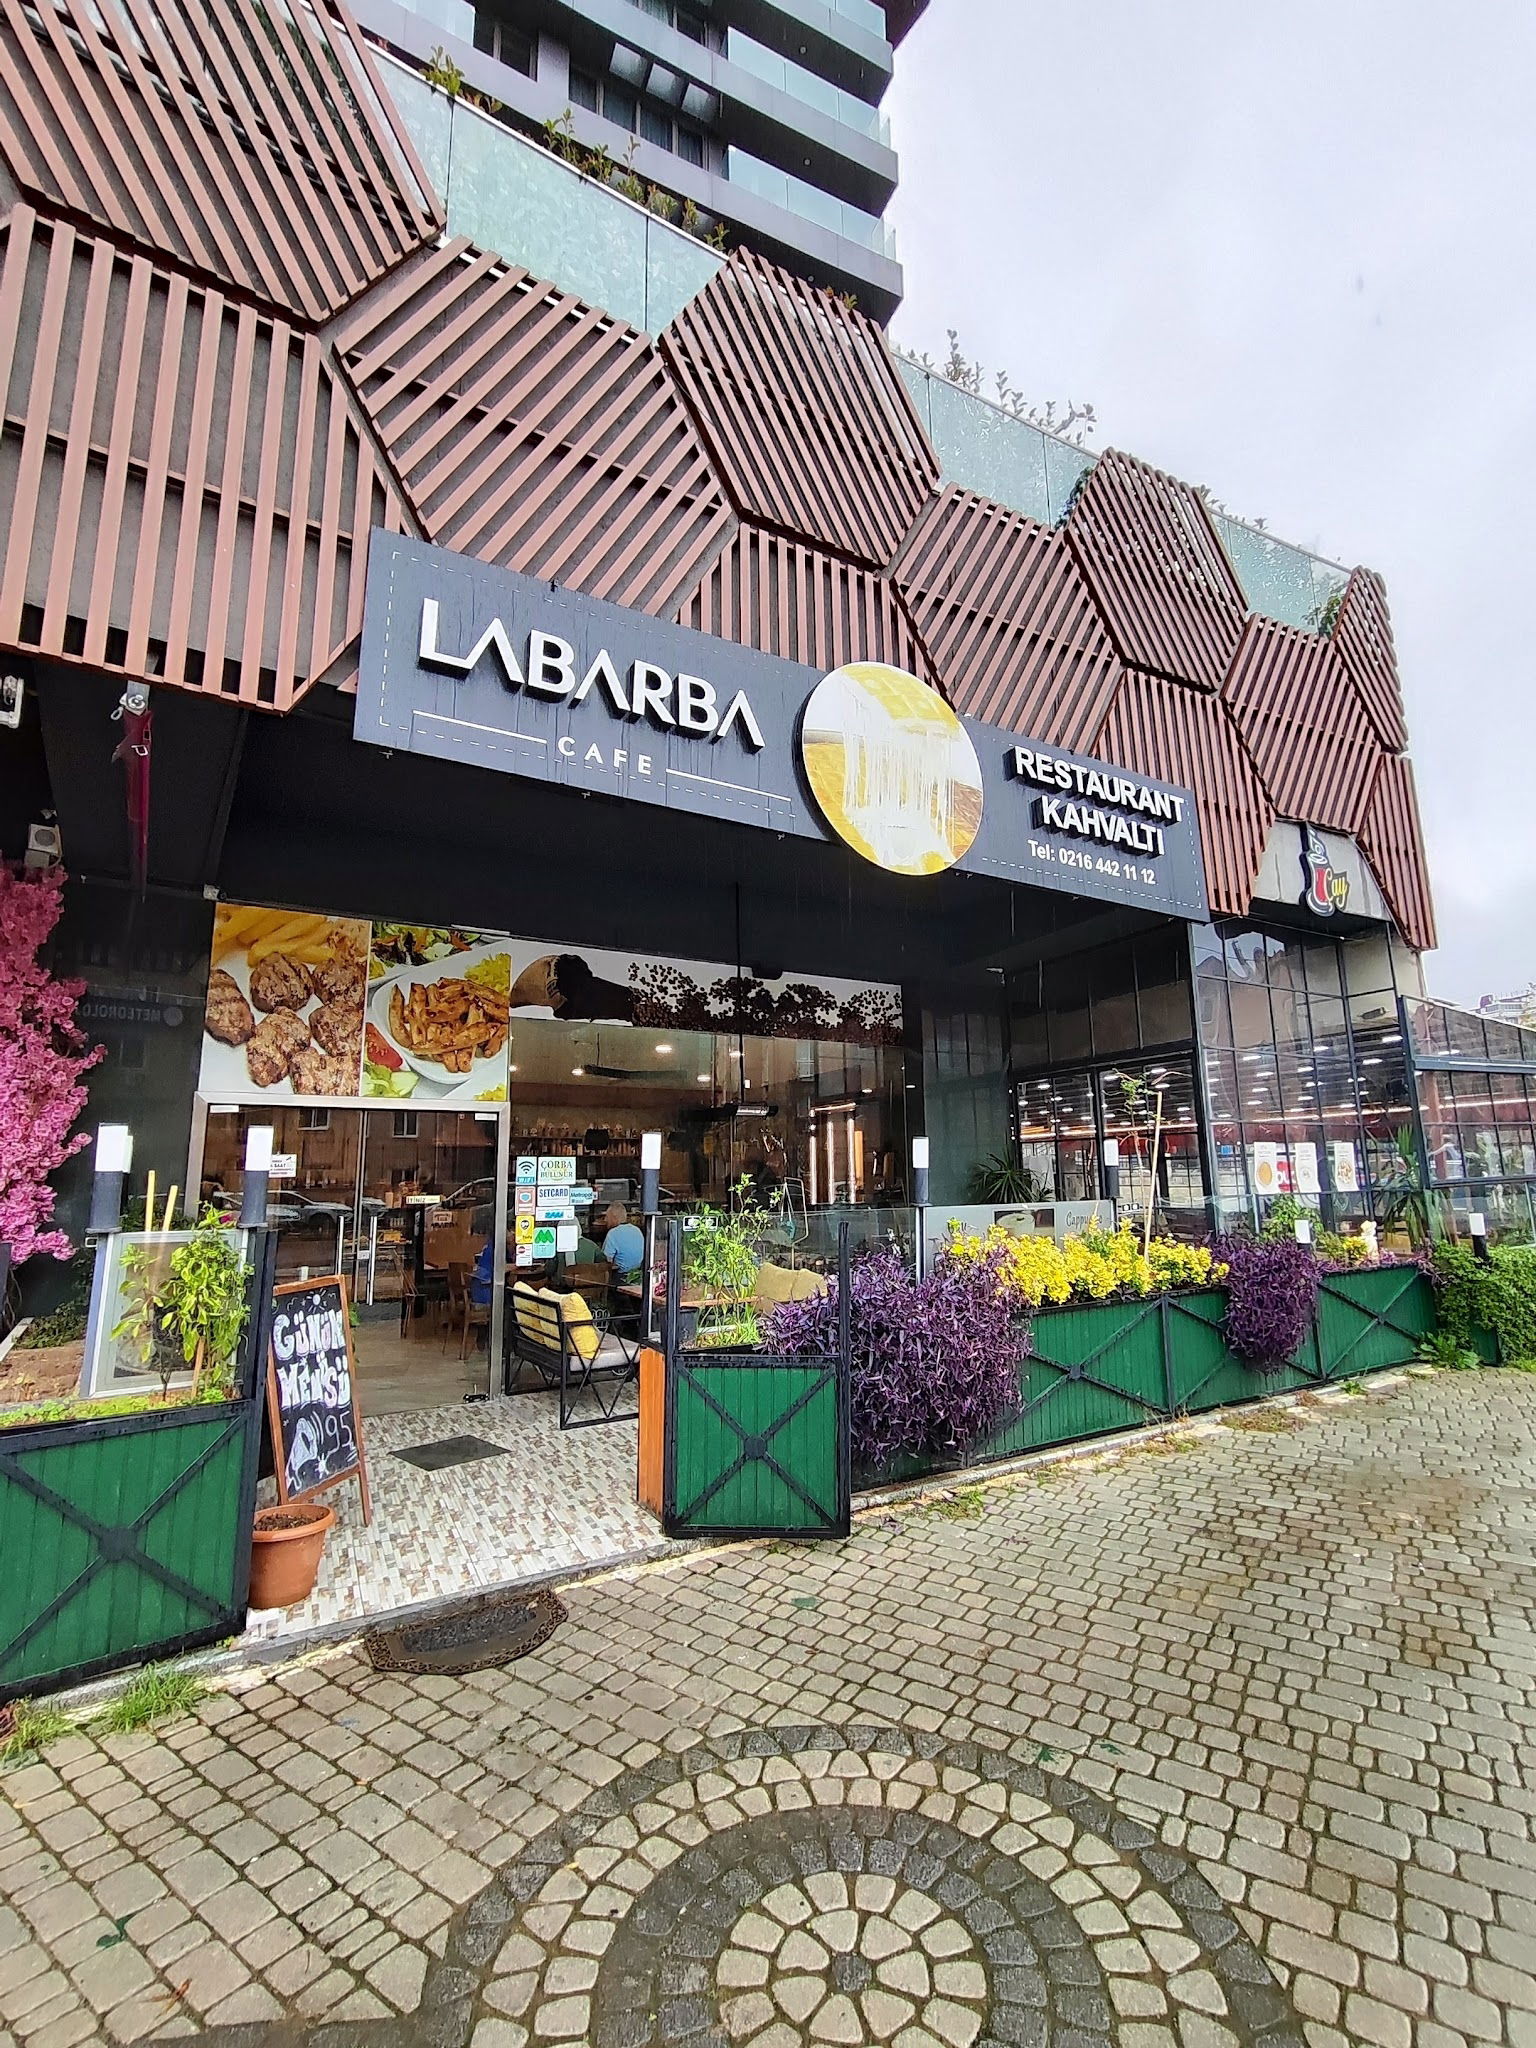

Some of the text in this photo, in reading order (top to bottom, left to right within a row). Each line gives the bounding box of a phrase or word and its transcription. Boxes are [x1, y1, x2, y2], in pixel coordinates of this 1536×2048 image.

[419, 598, 765, 749] LABARBA
[557, 735, 653, 775] CAFE
[1014, 746, 1185, 823] RESTAURANT
[1041, 795, 1165, 856] KAHVALTI
[1027, 839, 1156, 885] Tel: 0216 442 11 12
[540, 1160, 573, 1171] ÇORBA
[538, 1188, 569, 1198] SETCARD
